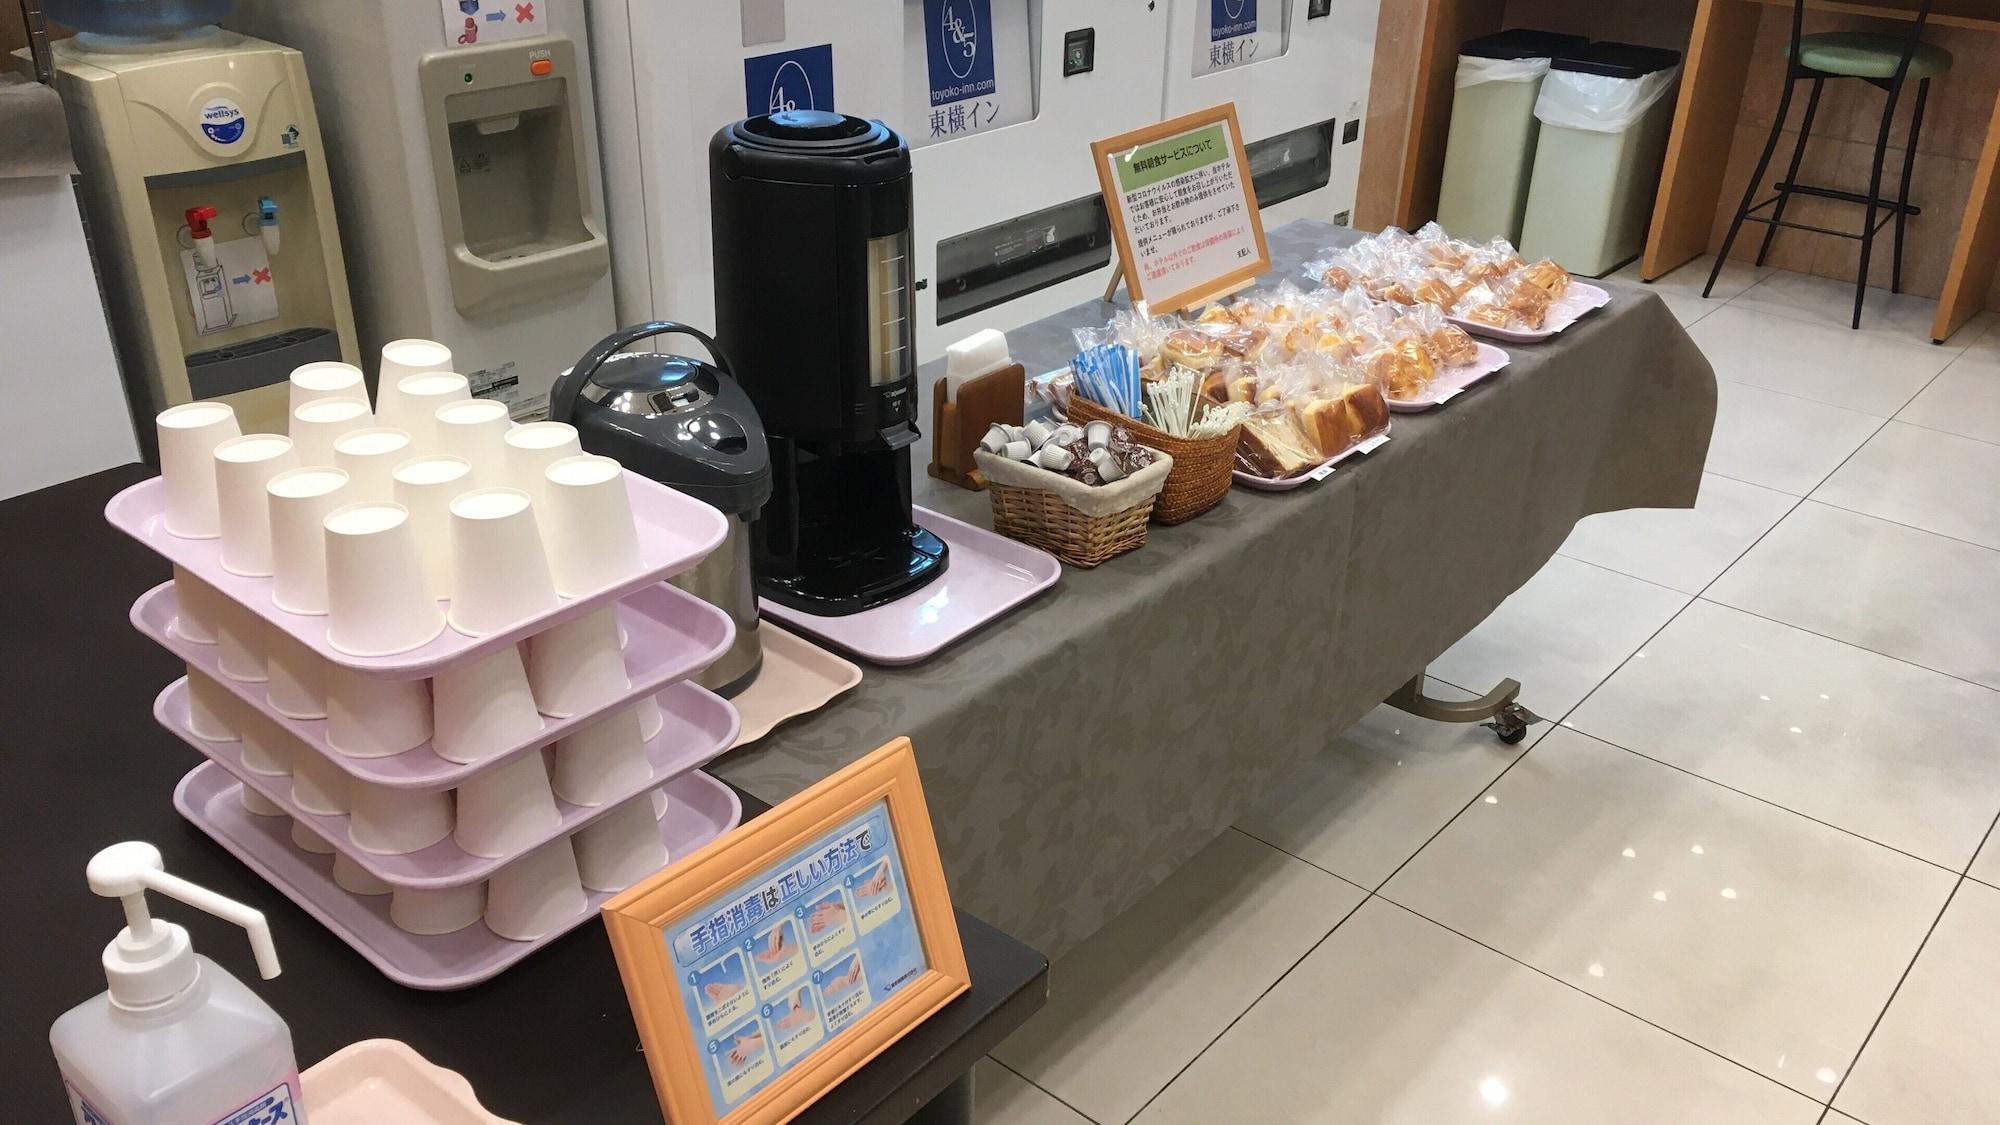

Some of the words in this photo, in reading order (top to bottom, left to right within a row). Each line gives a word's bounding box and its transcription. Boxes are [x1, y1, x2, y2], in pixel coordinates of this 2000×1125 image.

[943, 5, 976, 58] 4&5
[1212, 20, 1257, 38] toyoko-inn.com
[529, 49, 551, 59] PUSH
[1208, 38, 1260, 69] 東横イン
[931, 79, 995, 102] toyoko-inn.com
[203, 107, 240, 120] wellsys
[928, 100, 1001, 138] 東横イン
[1132, 139, 1213, 174] 無料朝食サービスについて
[845, 877, 852, 887] 4
[690, 829, 872, 955] 手指消毒は正しい方法で
[796, 907, 804, 918] 3
[744, 939, 751, 950] 2
[763, 1005, 771, 1016] 6
[709, 1041, 717, 1052] 5
